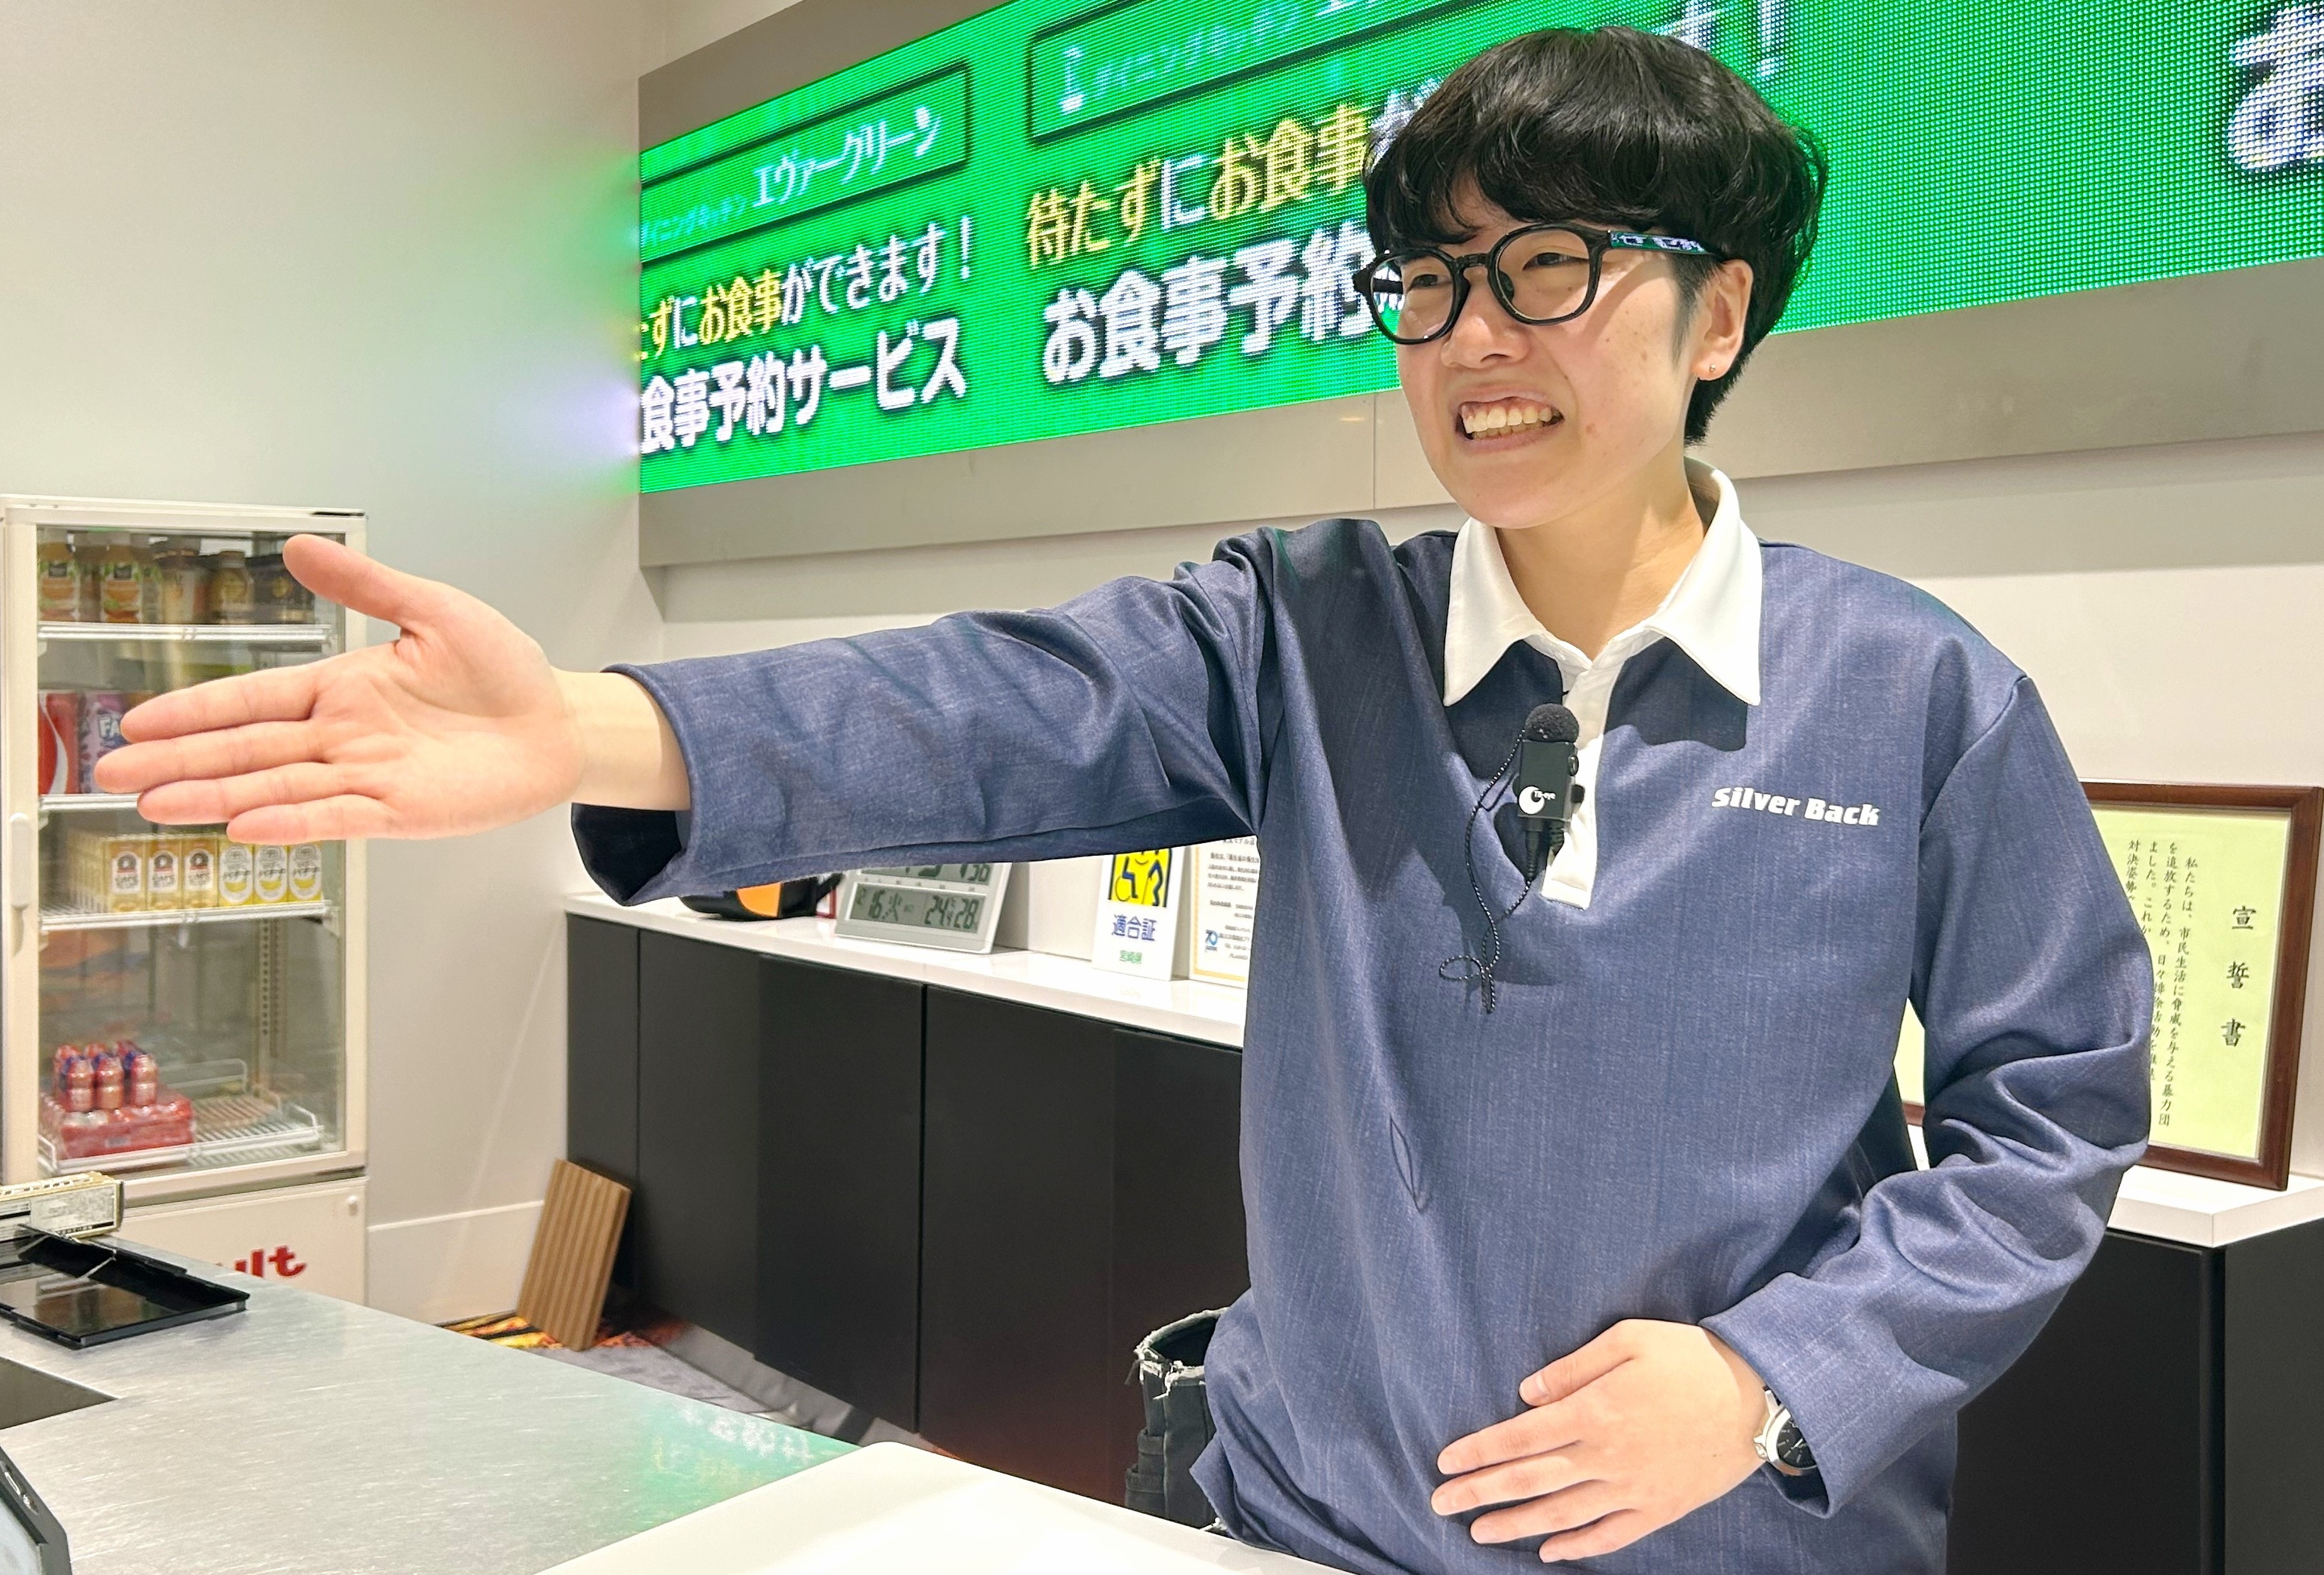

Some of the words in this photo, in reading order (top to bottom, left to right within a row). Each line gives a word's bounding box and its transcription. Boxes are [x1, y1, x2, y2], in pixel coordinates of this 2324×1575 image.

[641, 317, 968, 454] 食事予約サービス
[1711, 787, 1800, 817] Silver
[1804, 797, 1881, 826] Back
[1111, 913, 1157, 941] 適合証
[2220, 905, 2255, 1047] 宣誓書
[235, 1244, 307, 1278] lt
